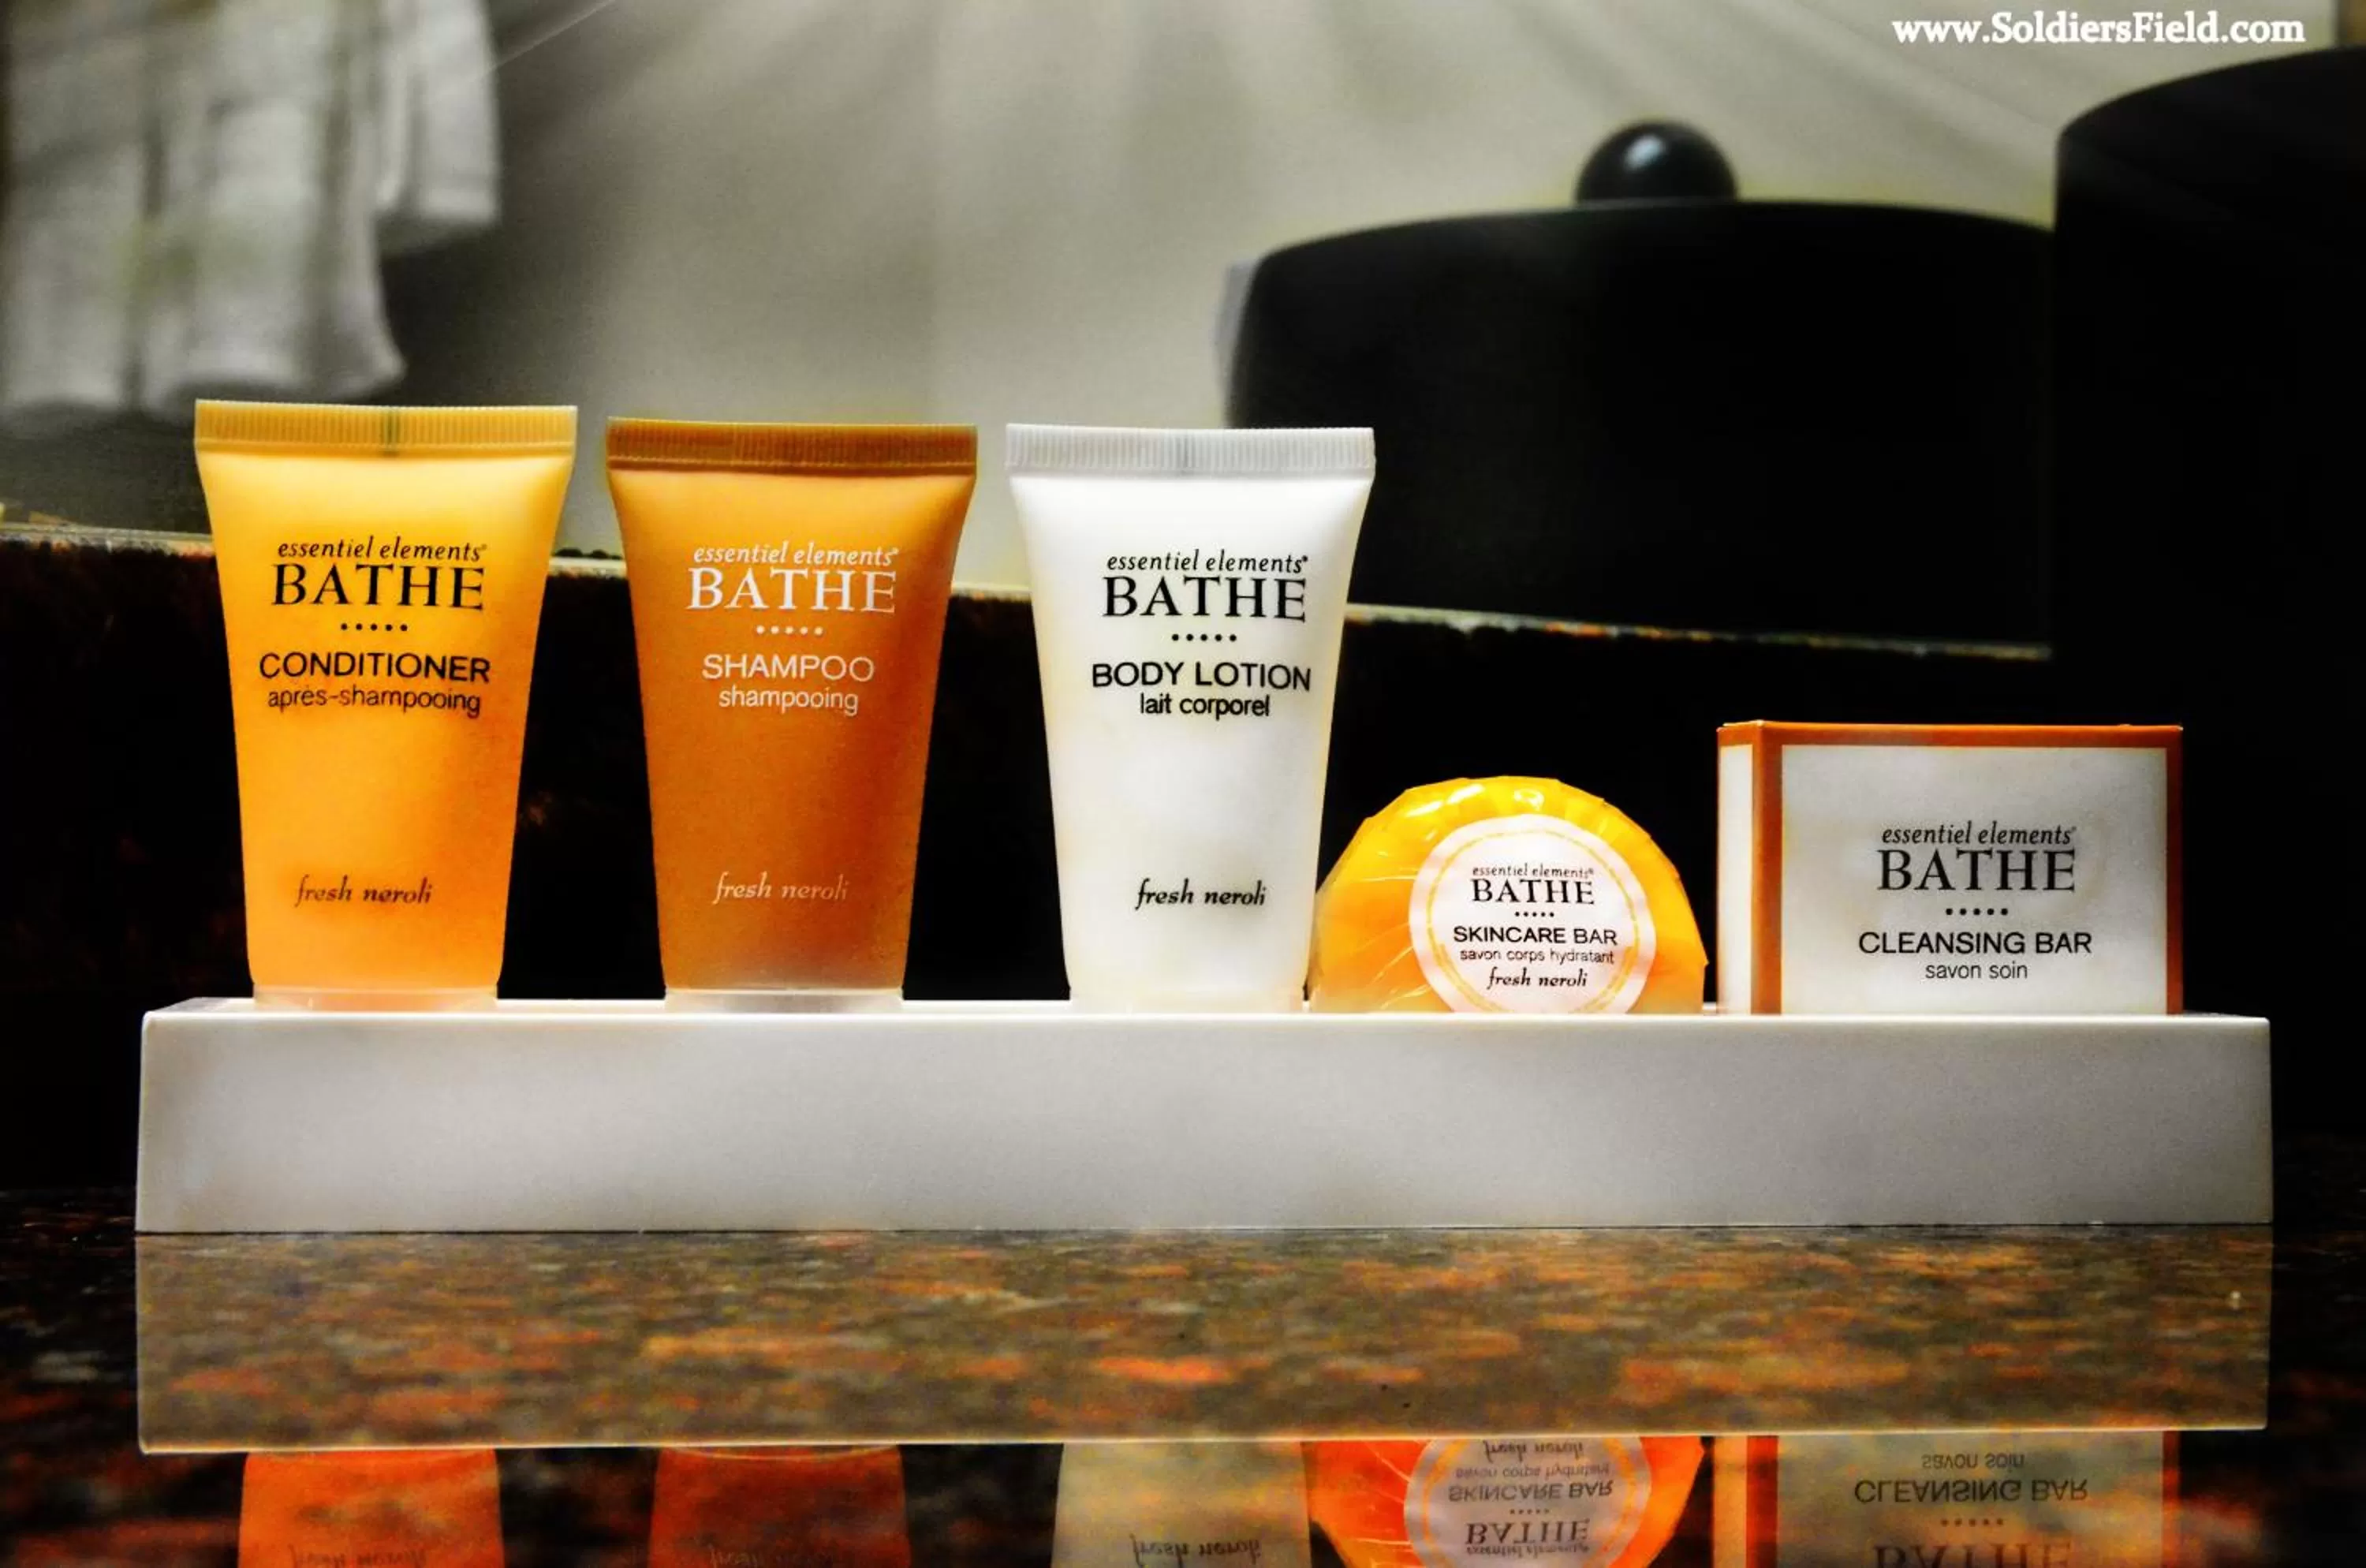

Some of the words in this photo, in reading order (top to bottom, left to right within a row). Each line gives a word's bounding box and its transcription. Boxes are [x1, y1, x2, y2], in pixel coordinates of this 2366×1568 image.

[278, 536, 373, 559] essentiel
[693, 540, 788, 564] essentiel
[1106, 548, 1200, 571] essentiel
[271, 562, 484, 611] BATHE
[685, 566, 897, 614] BATHE
[1102, 575, 1307, 623] BATHE
[259, 651, 491, 684] CONDITIONER
[702, 653, 875, 682] SHAMPOO
[1092, 662, 1184, 688] BODY
[1195, 662, 1312, 692] LOTION
[718, 684, 859, 716] shampooing
[1140, 693, 1173, 715] lait
[1179, 694, 1271, 721] corporel
[1882, 819, 1972, 844] essentiel
[1472, 863, 1528, 876] essentiel
[1877, 848, 2076, 892] BATHE
[294, 874, 353, 907] fresh
[363, 876, 432, 903] neroli
[711, 870, 772, 905] fresh
[781, 873, 849, 901] neroli
[1135, 877, 1194, 910] fresh
[1204, 879, 1267, 906] neroli
[1472, 878, 1595, 905] BATHE
[1454, 925, 1566, 945] SKINCARE
[1573, 928, 1618, 946] BAR
[1858, 931, 2025, 954] CLEANSING
[2036, 931, 2092, 954] BAR
[1460, 950, 1502, 961] savon
[1506, 950, 1545, 964] corps
[1550, 949, 1614, 965] hydratant
[1925, 964, 1981, 980] savon
[1988, 960, 2028, 980] soin
[1487, 966, 1531, 990] fresh
[1537, 968, 1588, 987] neroli
